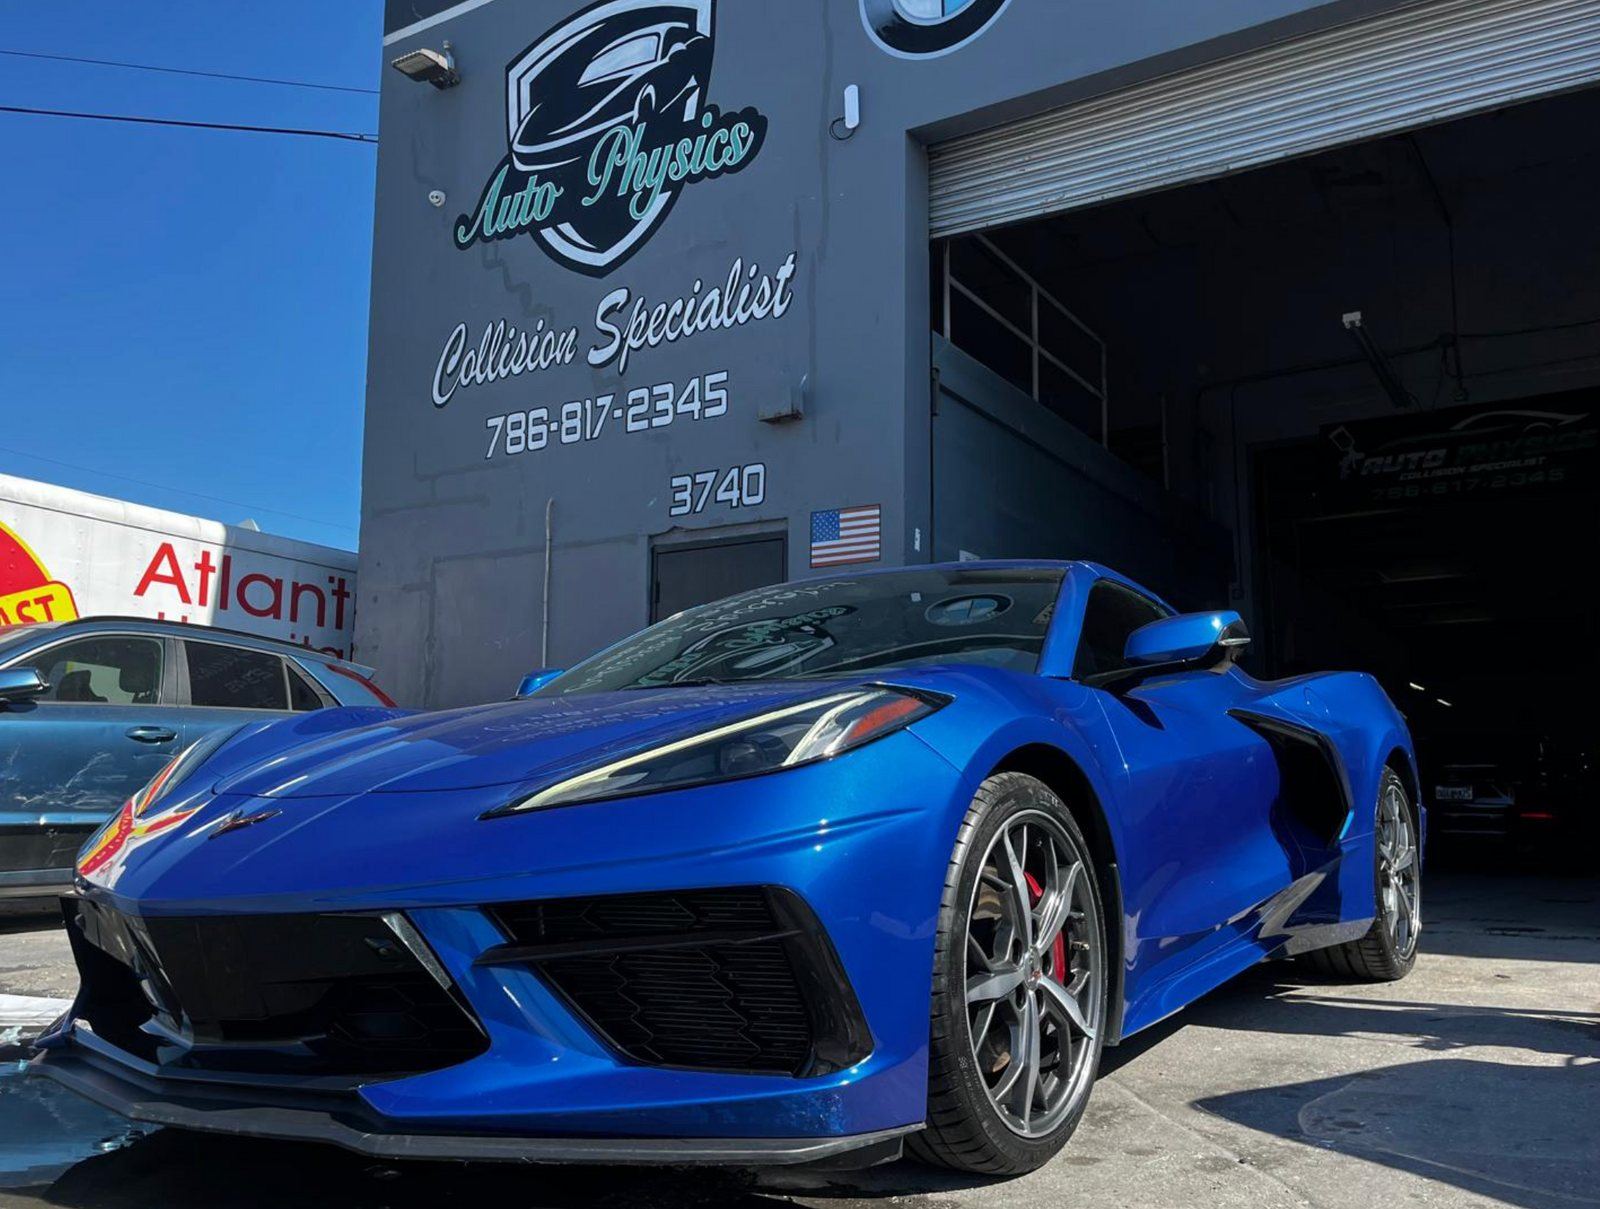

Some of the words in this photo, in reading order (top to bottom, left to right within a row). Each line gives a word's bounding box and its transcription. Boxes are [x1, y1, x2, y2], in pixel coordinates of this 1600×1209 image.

[457, 163, 564, 243] Auto
[581, 112, 755, 220] Physics
[432, 321, 577, 405] Collision
[587, 251, 797, 374] Specialist
[486, 370, 728, 458] 786-817-2345
[669, 463, 766, 517] 3740
